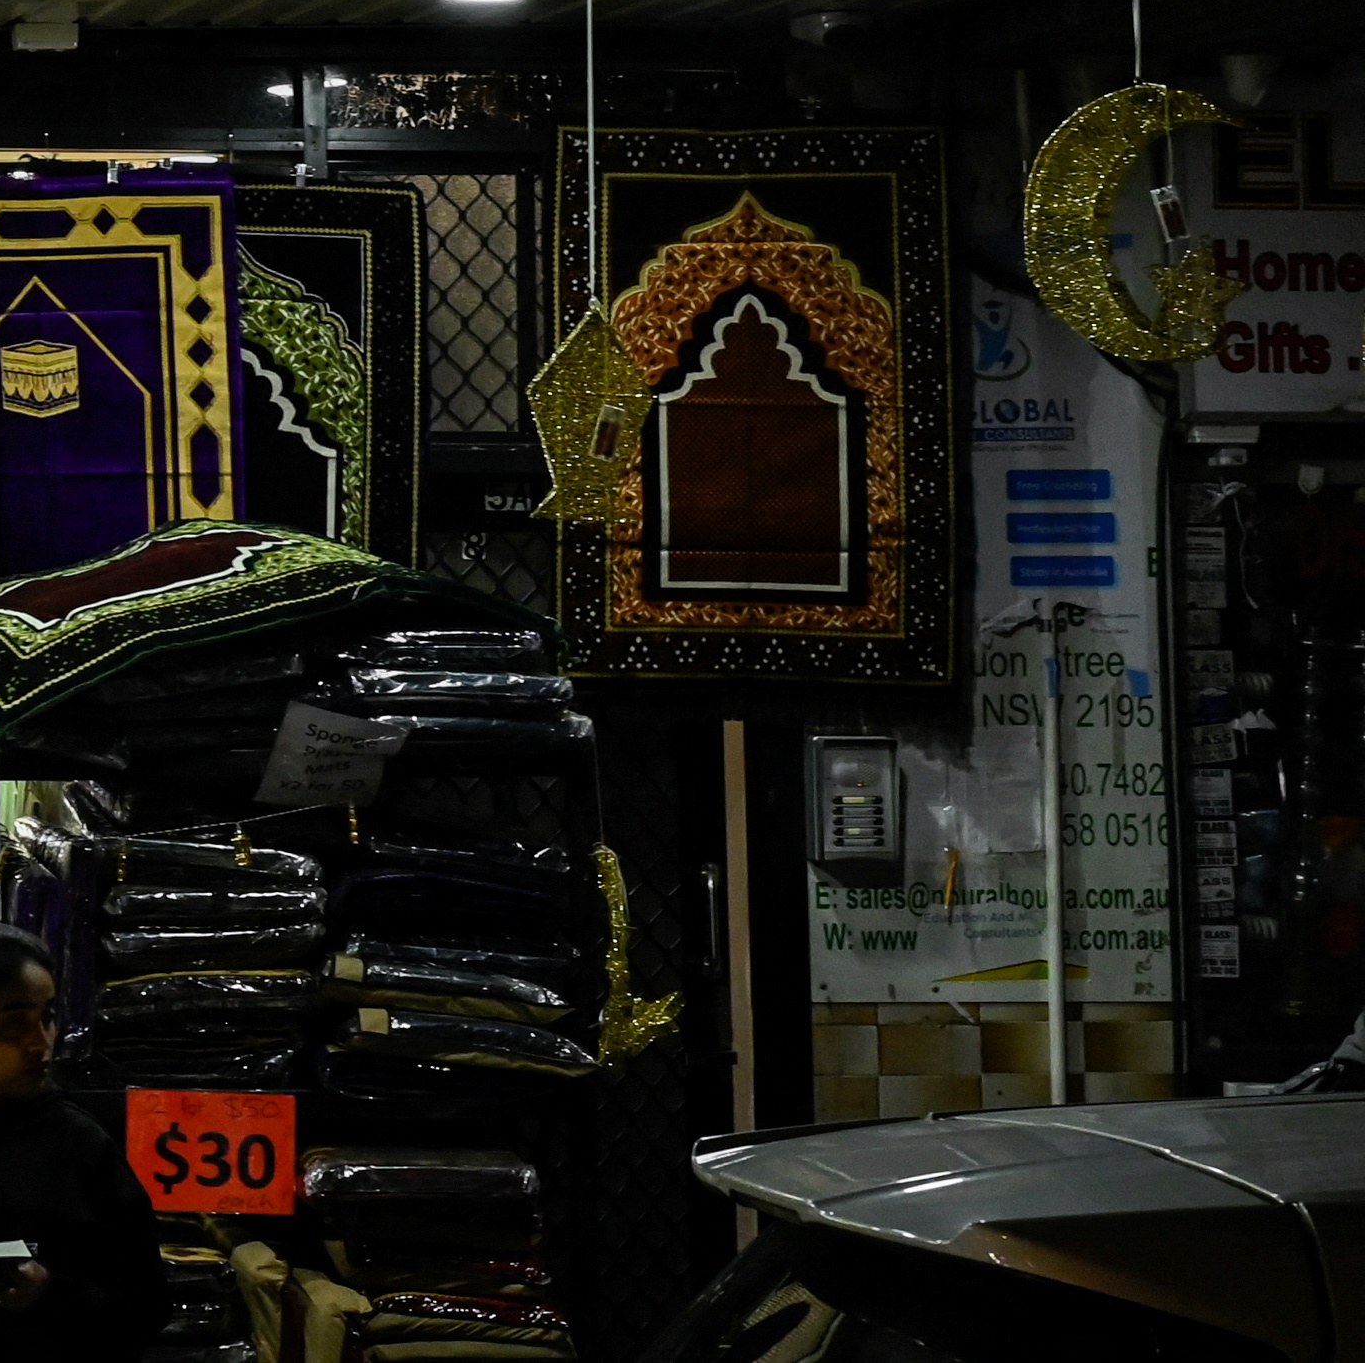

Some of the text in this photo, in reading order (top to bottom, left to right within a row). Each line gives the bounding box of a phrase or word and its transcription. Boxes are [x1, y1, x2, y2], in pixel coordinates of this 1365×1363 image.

[1213, 239, 1365, 292] Home
[971, 398, 1075, 424] LOBAL
[1076, 693, 1155, 728] 2195
[1096, 762, 1166, 797] 7482
[815, 881, 838, 910] E:
[822, 922, 854, 951] W:
[223, 1094, 280, 1119] $50
[154, 1122, 276, 1195] $30
